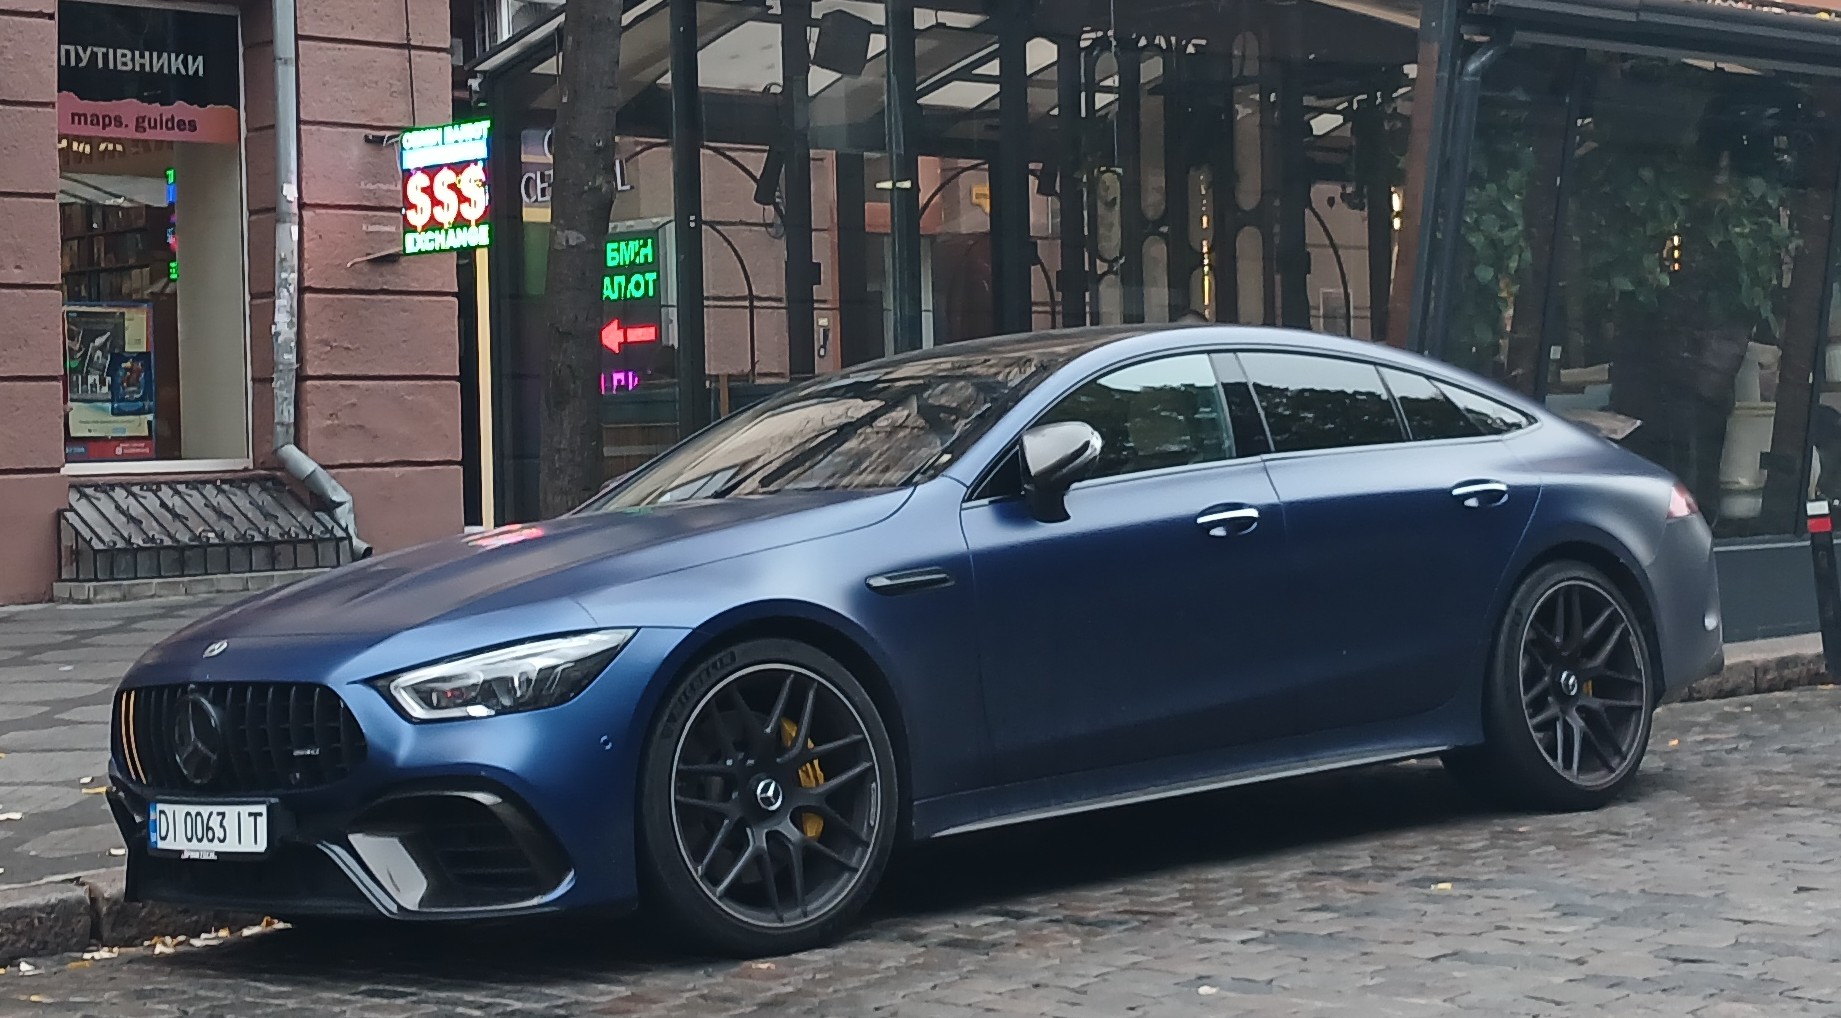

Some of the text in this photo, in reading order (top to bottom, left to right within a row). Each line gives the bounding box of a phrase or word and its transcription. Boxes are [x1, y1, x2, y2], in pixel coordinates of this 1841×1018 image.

[60, 44, 204, 77] ПУТІВНИКИ
[70, 111, 199, 134] maps. guides
[404, 224, 490, 254] EXCHANGE
[606, 239, 653, 267] БМІН
[602, 272, 657, 300] АЛЮТ
[158, 808, 264, 846] DI 0063 IT
